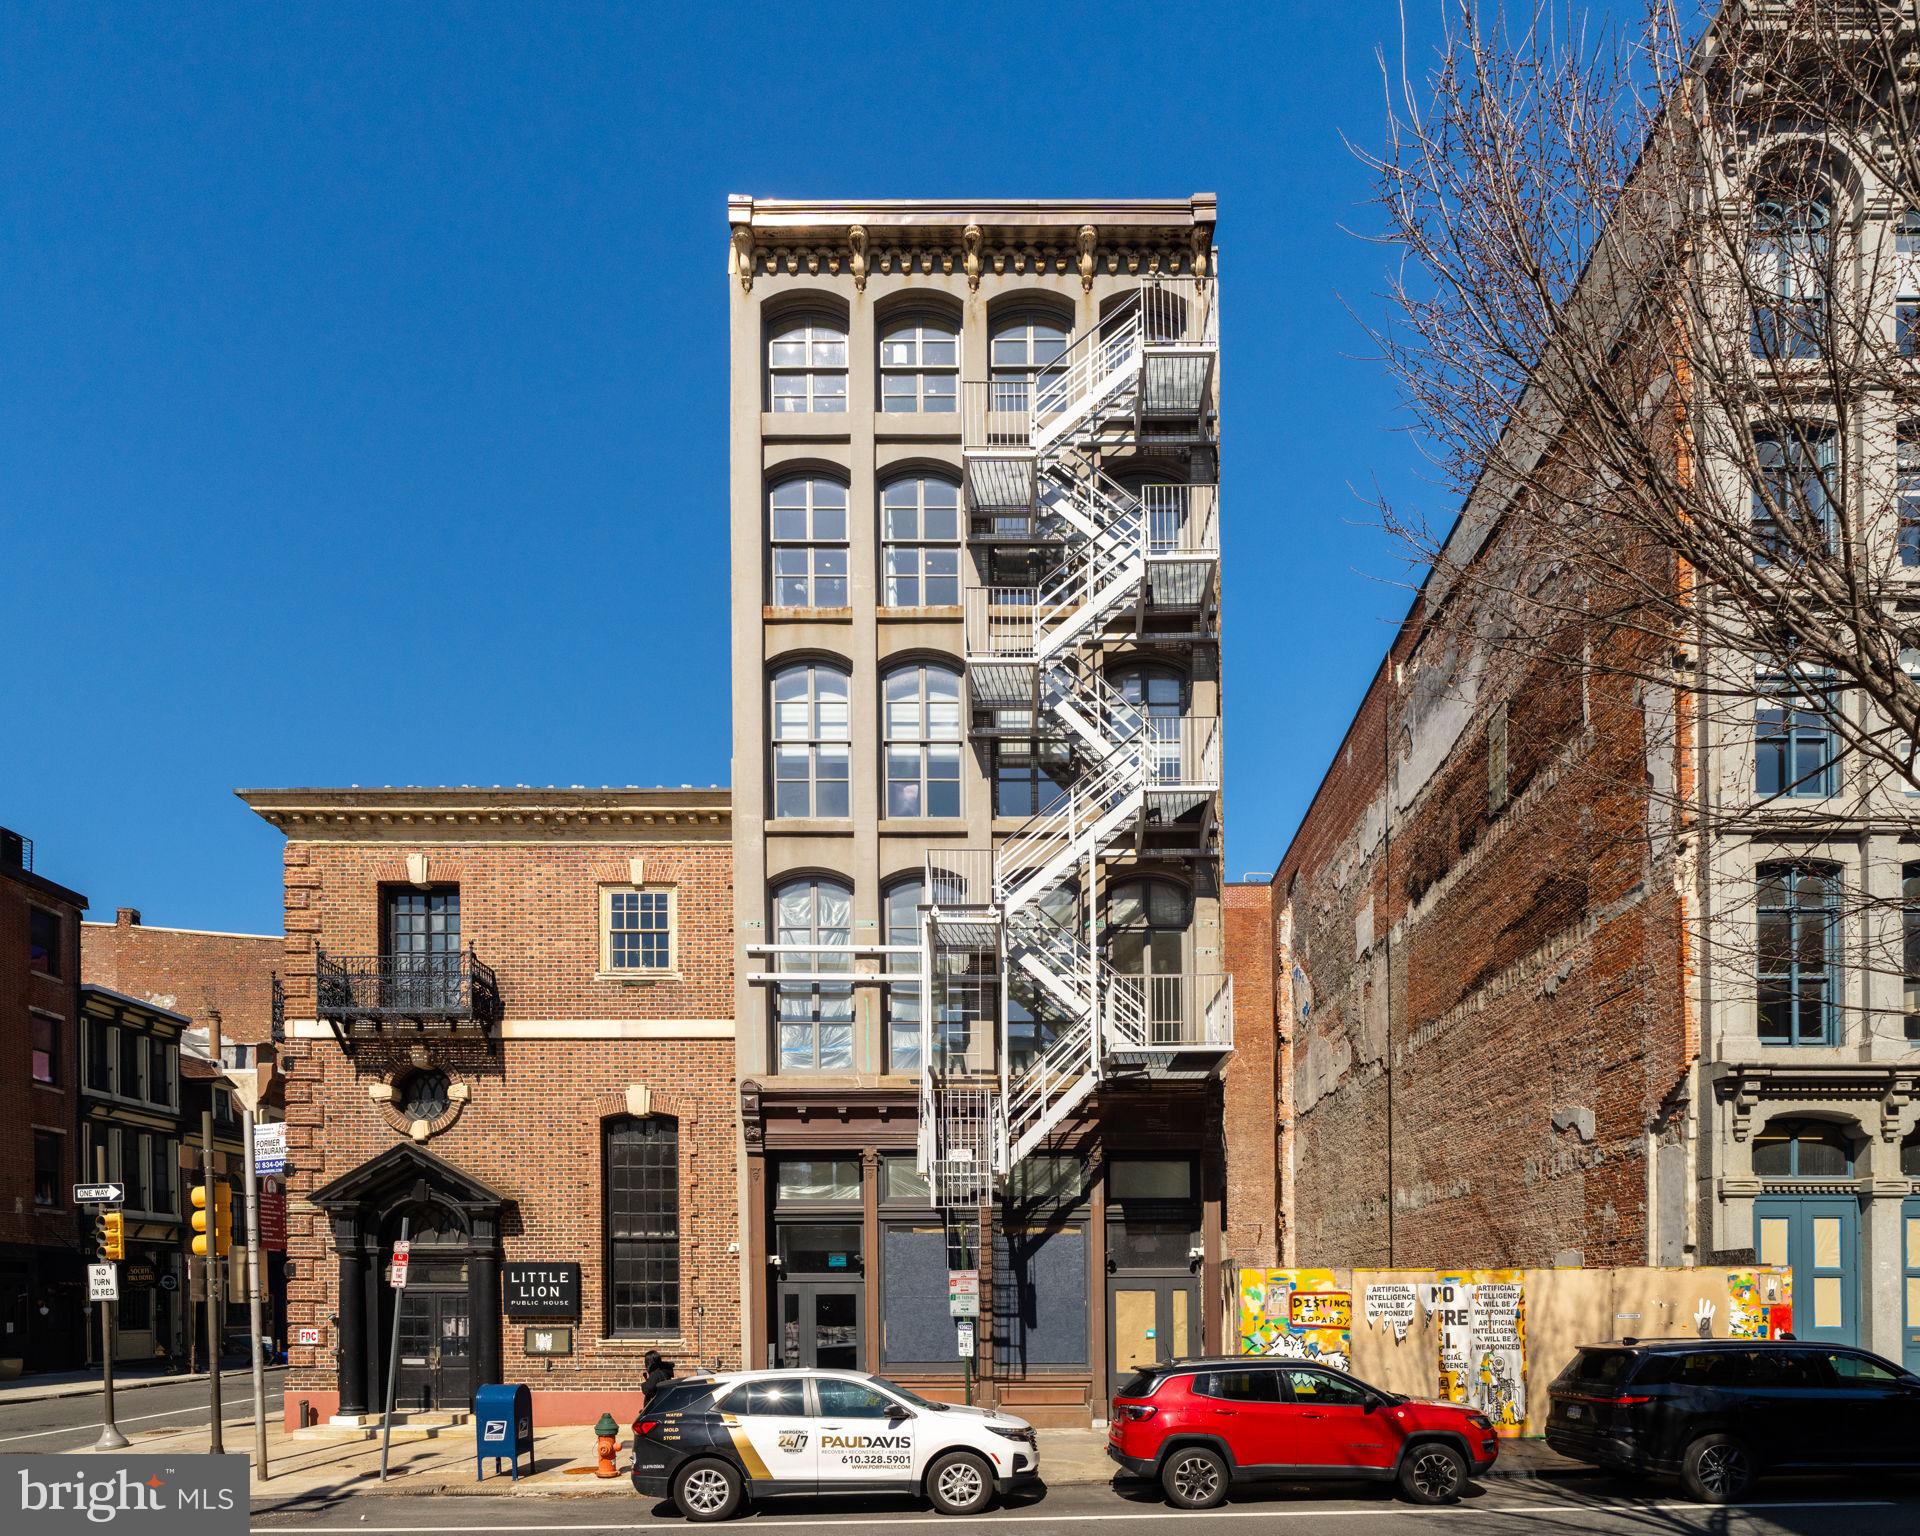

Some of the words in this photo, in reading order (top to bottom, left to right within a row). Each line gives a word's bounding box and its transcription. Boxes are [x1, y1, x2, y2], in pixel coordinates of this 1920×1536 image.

[256, 1138, 280, 1148] FORMER
[254, 1147, 287, 1156] ESTAURANT
[95, 1189, 109, 1197] WAY
[96, 1268, 107, 1276] NO
[511, 1271, 569, 1283] LITTLE
[94, 1278, 111, 1286] TURN
[520, 1286, 560, 1297] LION
[1366, 1293, 1416, 1301] INTELLIGENCE
[301, 1331, 317, 1342] FDC
[1475, 1343, 1520, 1351] WEAPONIZED
[778, 1434, 809, 1449] 24/7
[841, 1455, 911, 1464] 610.328.5901
